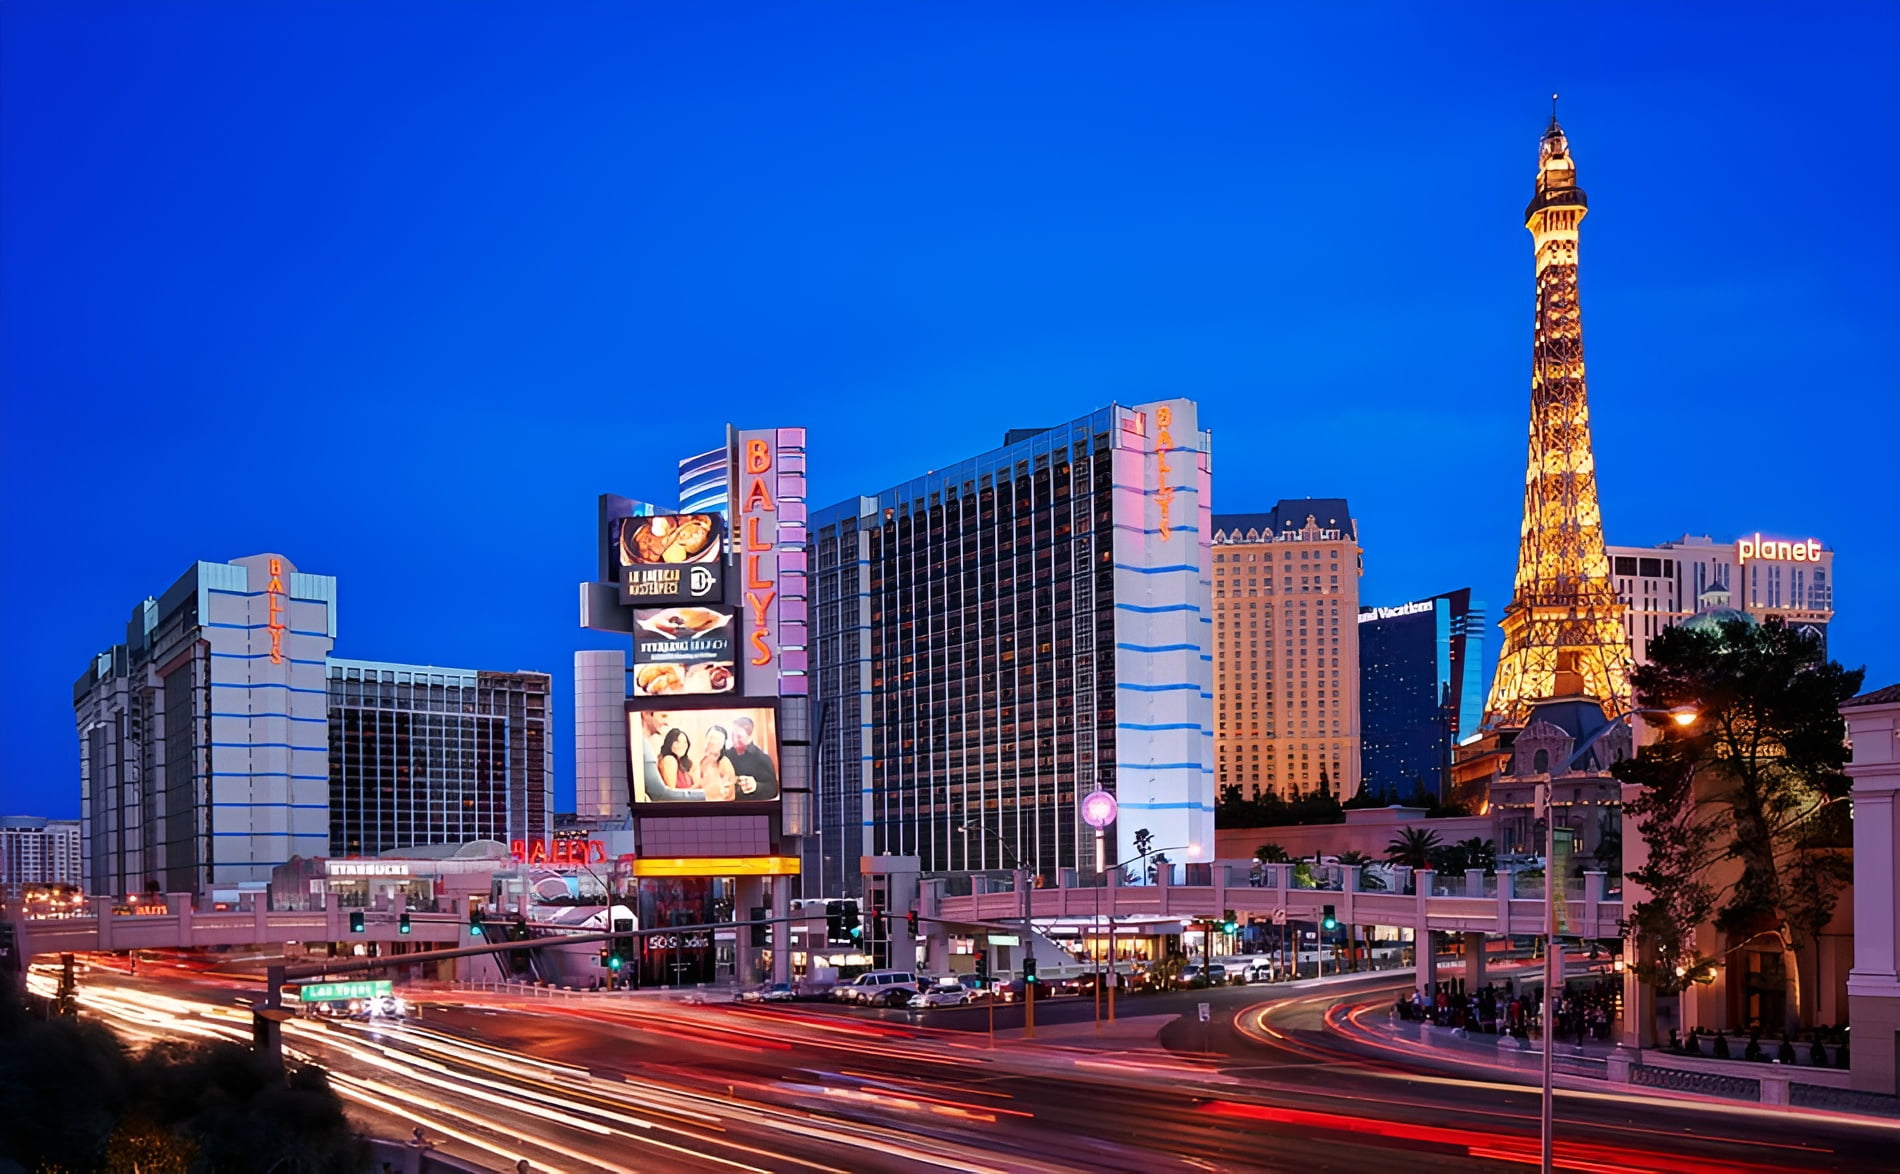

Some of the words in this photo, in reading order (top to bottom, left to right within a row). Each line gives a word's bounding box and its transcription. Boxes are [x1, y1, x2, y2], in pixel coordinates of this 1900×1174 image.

[745, 439, 775, 666] BALLYS
[1737, 532, 1821, 565] planet
[1378, 600, 1433, 619] Vacations
